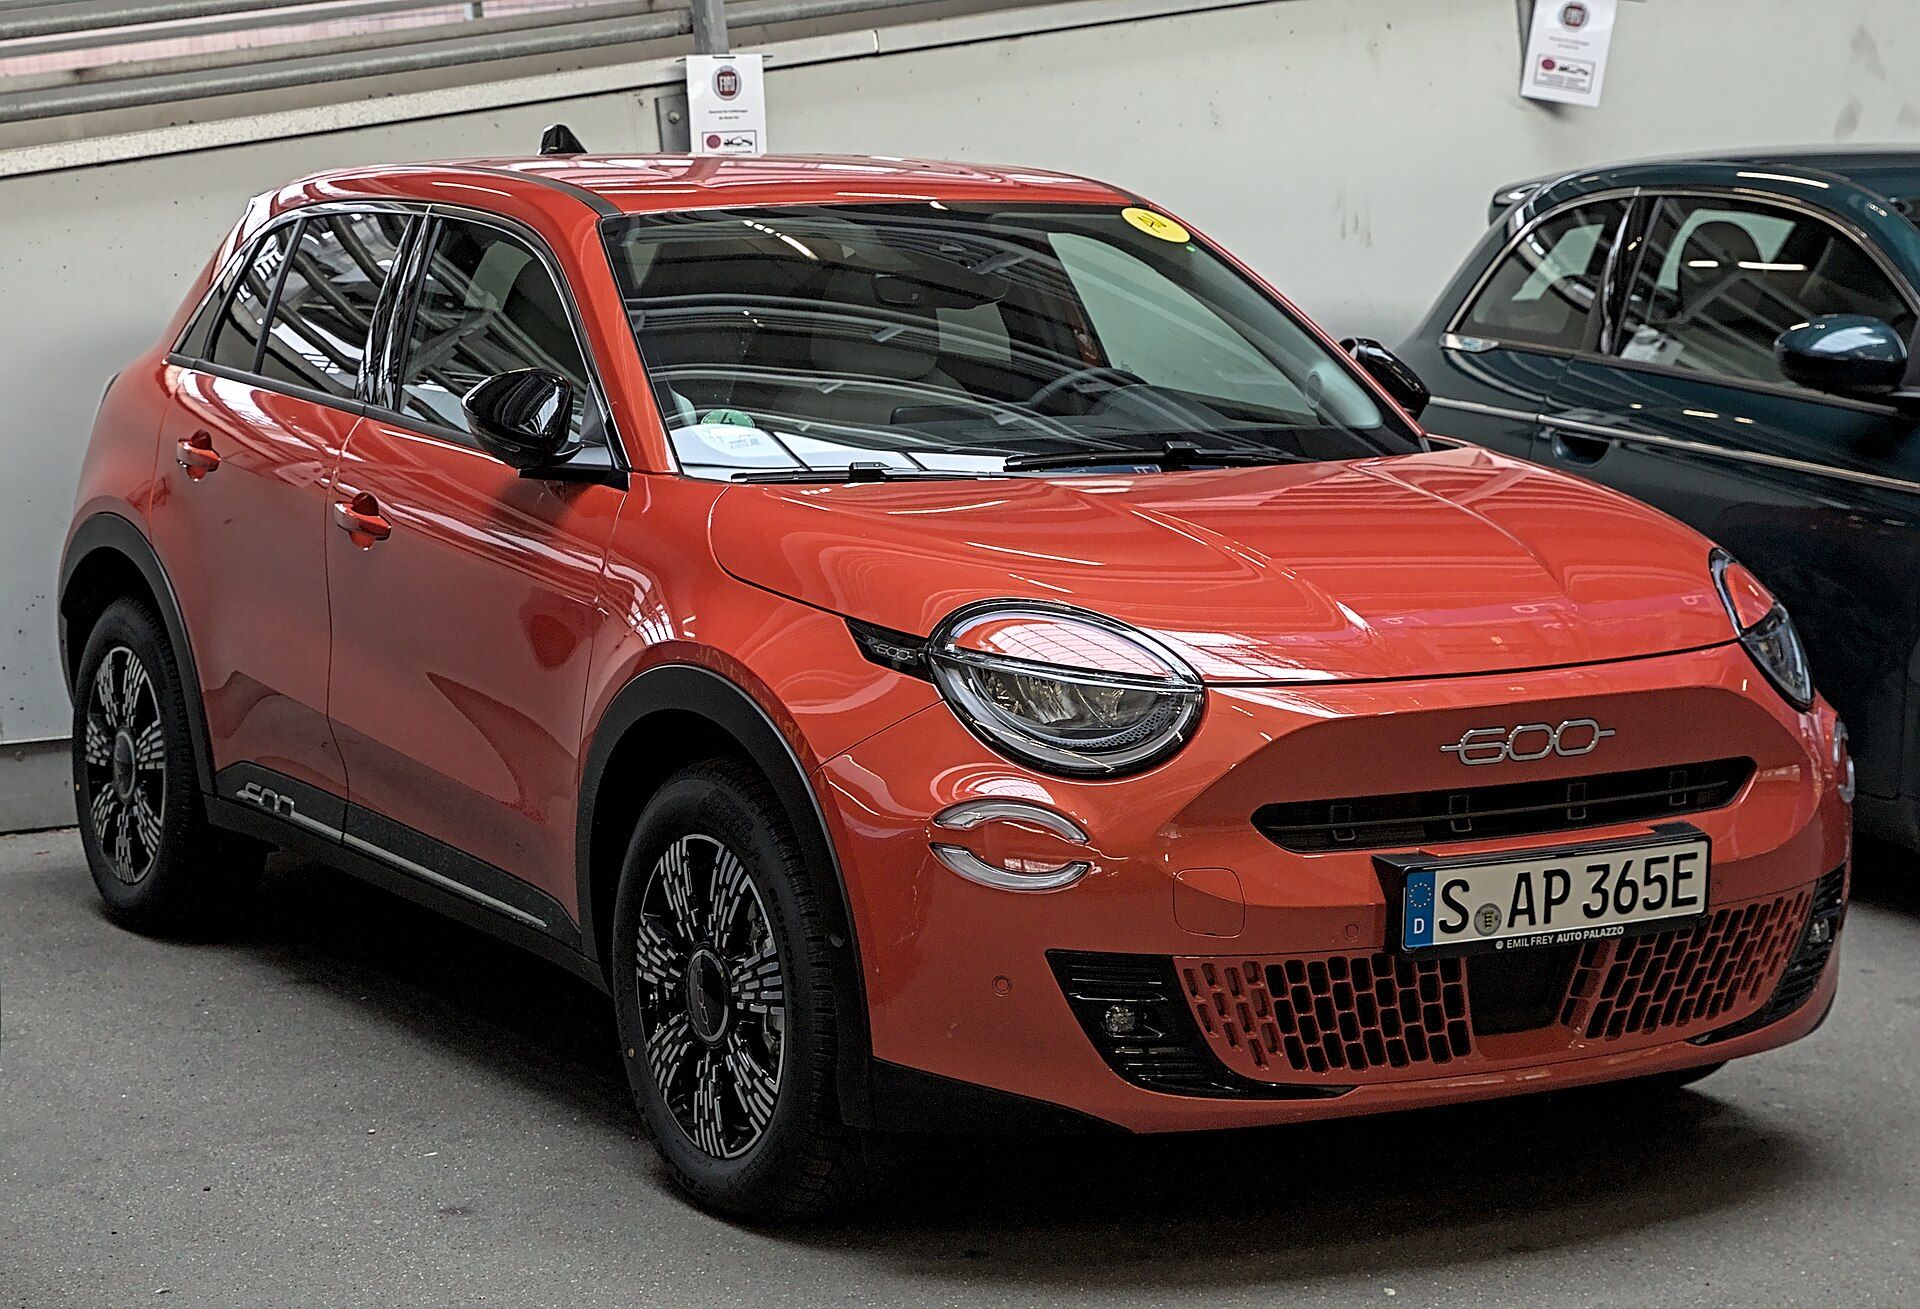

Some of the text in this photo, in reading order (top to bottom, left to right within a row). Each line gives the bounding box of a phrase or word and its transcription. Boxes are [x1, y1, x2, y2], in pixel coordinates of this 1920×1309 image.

[876, 643, 911, 661] 600
[1452, 717, 1607, 766] 600
[1438, 851, 1699, 934] S AP 365E
[1413, 917, 1425, 935] D
[1506, 925, 1625, 949] EMIL FREY AUTO PALAZZO
